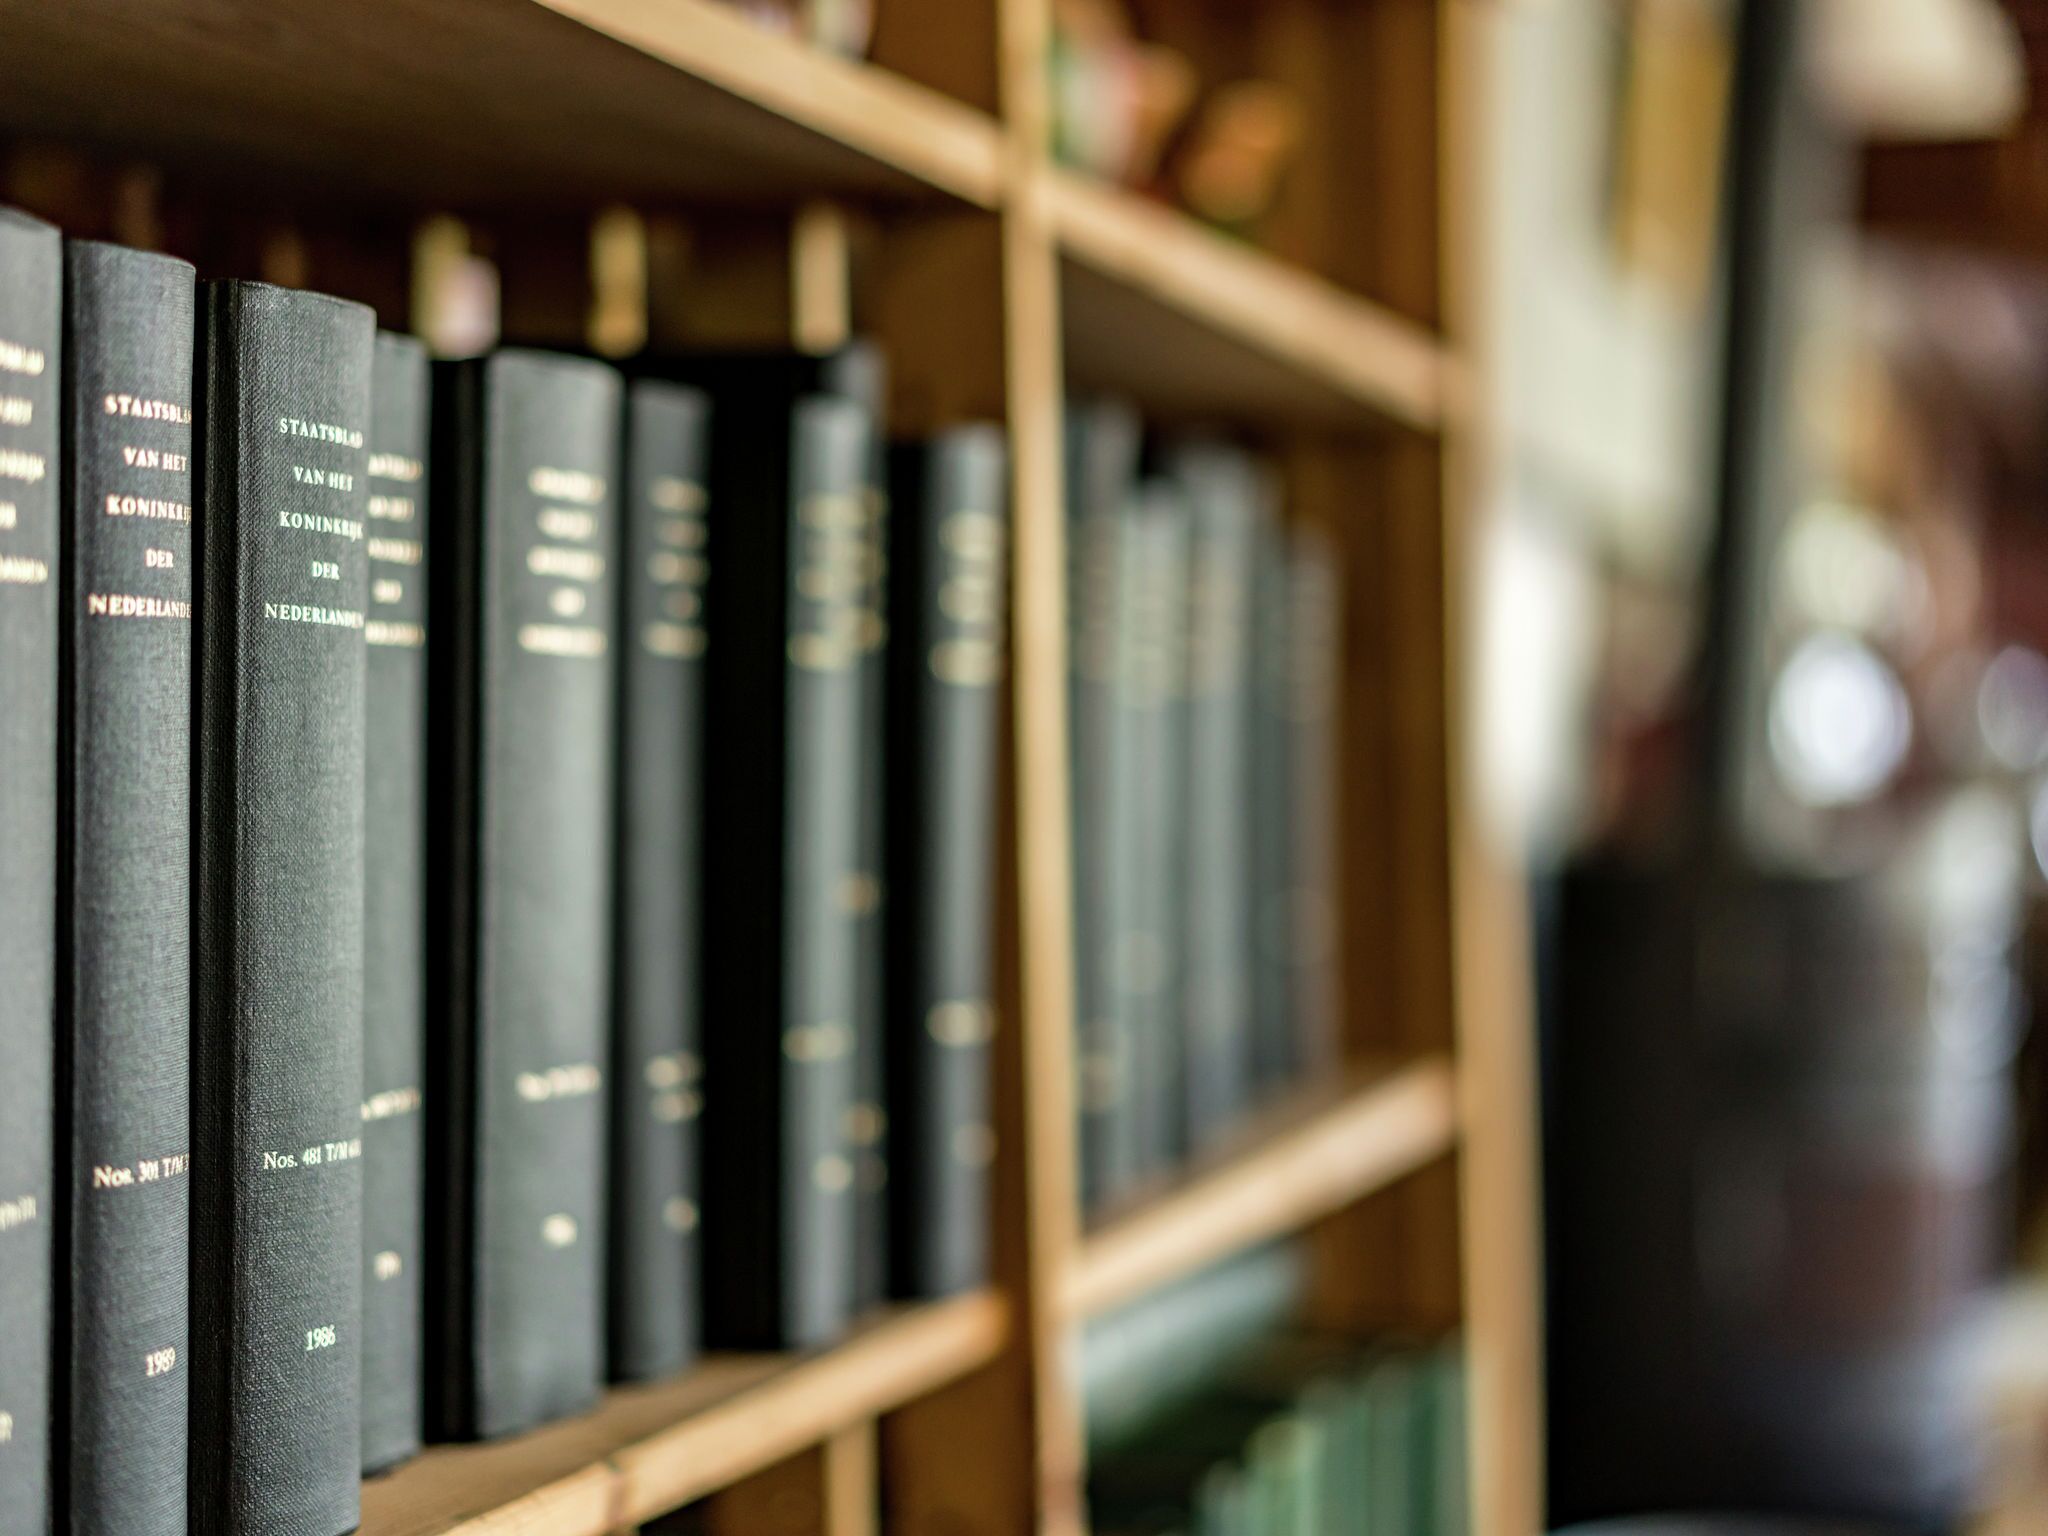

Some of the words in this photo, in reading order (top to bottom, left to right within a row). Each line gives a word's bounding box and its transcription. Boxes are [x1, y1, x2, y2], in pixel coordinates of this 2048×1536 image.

[279, 417, 363, 449] STAATSBLAD
[123, 446, 159, 468] VAN
[162, 453, 187, 472] HET
[293, 465, 325, 485] VAN
[328, 471, 353, 492] HET
[279, 510, 363, 542] KONINKRIJK
[145, 548, 174, 568] DER
[311, 561, 340, 580] DER
[88, 593, 192, 619] NEDERLANDE
[264, 603, 365, 629] NEDERLANDEN
[262, 1151, 298, 1169] Nos.
[302, 1146, 322, 1165] 481
[93, 1164, 135, 1189] Nos.
[138, 1160, 160, 1183] 301
[306, 1325, 336, 1351] 1986
[145, 1347, 176, 1376] 1989
